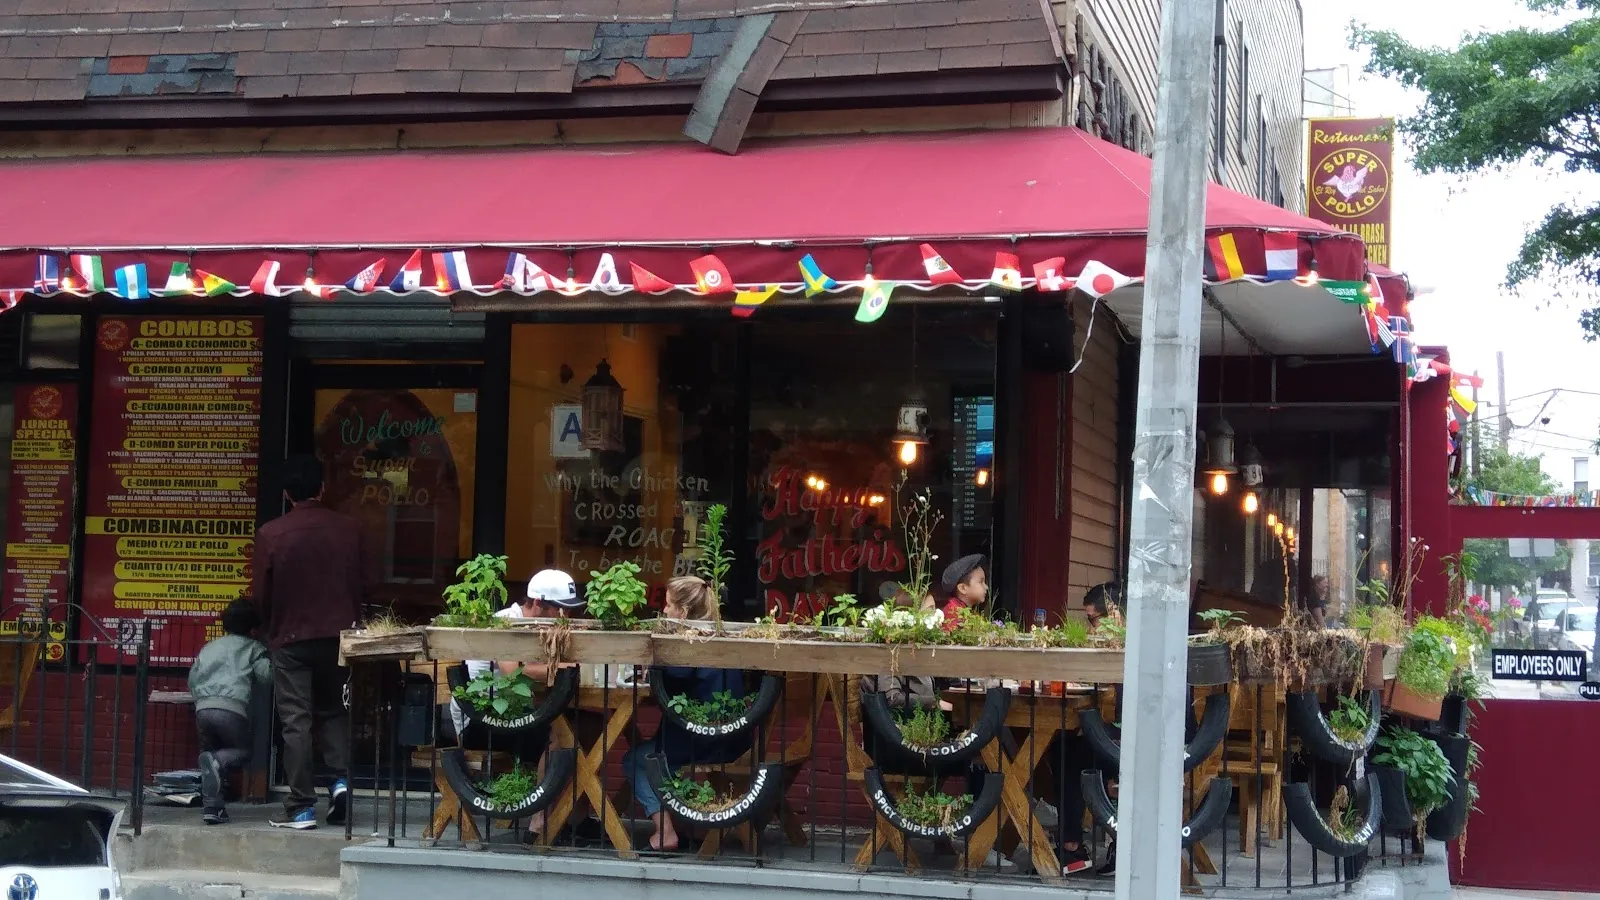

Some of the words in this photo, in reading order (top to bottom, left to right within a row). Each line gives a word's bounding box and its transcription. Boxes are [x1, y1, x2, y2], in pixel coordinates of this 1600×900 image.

[1323, 152, 1378, 174] SUPER
[1326, 194, 1375, 214] POLLO
[1360, 224, 1384, 244] BRASA
[140, 320, 254, 336] COMBOS
[132, 403, 204, 411] C-ECUADORIAN
[16, 430, 72, 439] SPECIAL
[22, 420, 68, 429] LUNCH
[340, 408, 446, 444] Welcome
[560, 412, 582, 442] A
[590, 464, 619, 488] the
[360, 484, 429, 506] POLLO
[762, 465, 870, 529] Happy
[104, 518, 256, 536] COMBINACIONE
[127, 540, 156, 548] MEDIO
[160, 540, 182, 548] (1/2)
[186, 540, 196, 549] DE
[200, 541, 228, 549] POLLO
[124, 563, 162, 571] CUARTO
[165, 563, 188, 571] (1/4)
[191, 563, 202, 572] DE
[205, 564, 233, 572] POLLO
[568, 550, 588, 570] To
[115, 600, 155, 609] SERVIDO
[158, 601, 176, 609] CON
[180, 601, 199, 609] UNA
[202, 602, 227, 610] OPCI
[1495, 655, 1554, 675] EMPLOYEES
[1556, 656, 1582, 676] ONLY
[1580, 686, 1600, 695] PUL
[482, 714, 535, 728] MARGARITA
[686, 722, 716, 736] PISCO
[721, 716, 748, 734] SOUR
[473, 797, 494, 811] OLD
[498, 786, 545, 813] FASHION
[662, 792, 704, 821] PALOMA
[708, 768, 768, 822] ECUATORIANA
[874, 790, 897, 818] SPICY
[900, 818, 935, 836] SUPER
